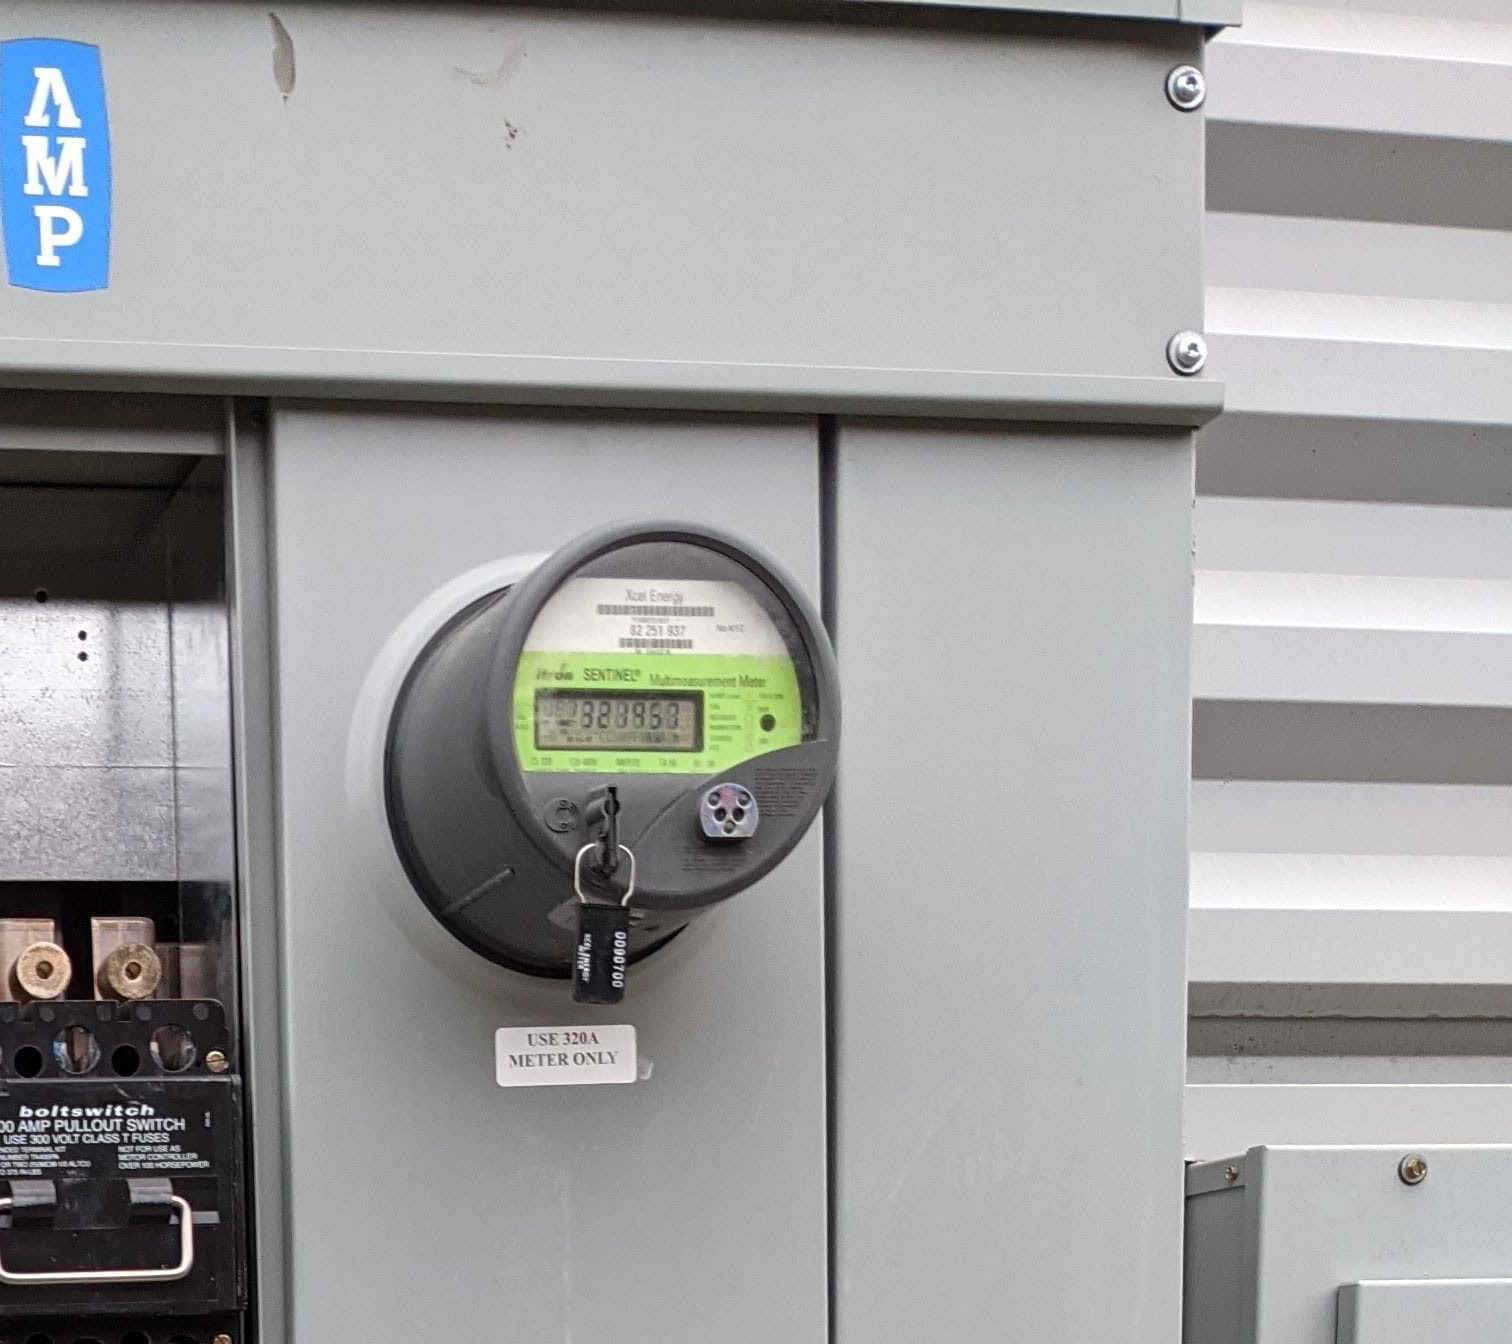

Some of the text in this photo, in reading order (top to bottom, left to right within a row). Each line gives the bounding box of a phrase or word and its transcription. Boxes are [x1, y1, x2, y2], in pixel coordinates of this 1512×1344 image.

[21, 67, 88, 267] AMP
[650, 590, 684, 604] Energy
[739, 675, 766, 689] Meter
[527, 1031, 599, 1047] USE 320A
[509, 1051, 618, 1068] METER ONLY
[19, 1104, 155, 1118] boltswitch
[17, 1119, 51, 1133] AMP
[53, 1119, 121, 1132] PULLOUT
[126, 1118, 186, 1131] SWITCH
[3, 1134, 27, 1145] USE
[29, 1134, 51, 1145] 300
[52, 1134, 80, 1144] VOLT
[82, 1133, 120, 1144] CLASS
[131, 1133, 170, 1143] FUSES
